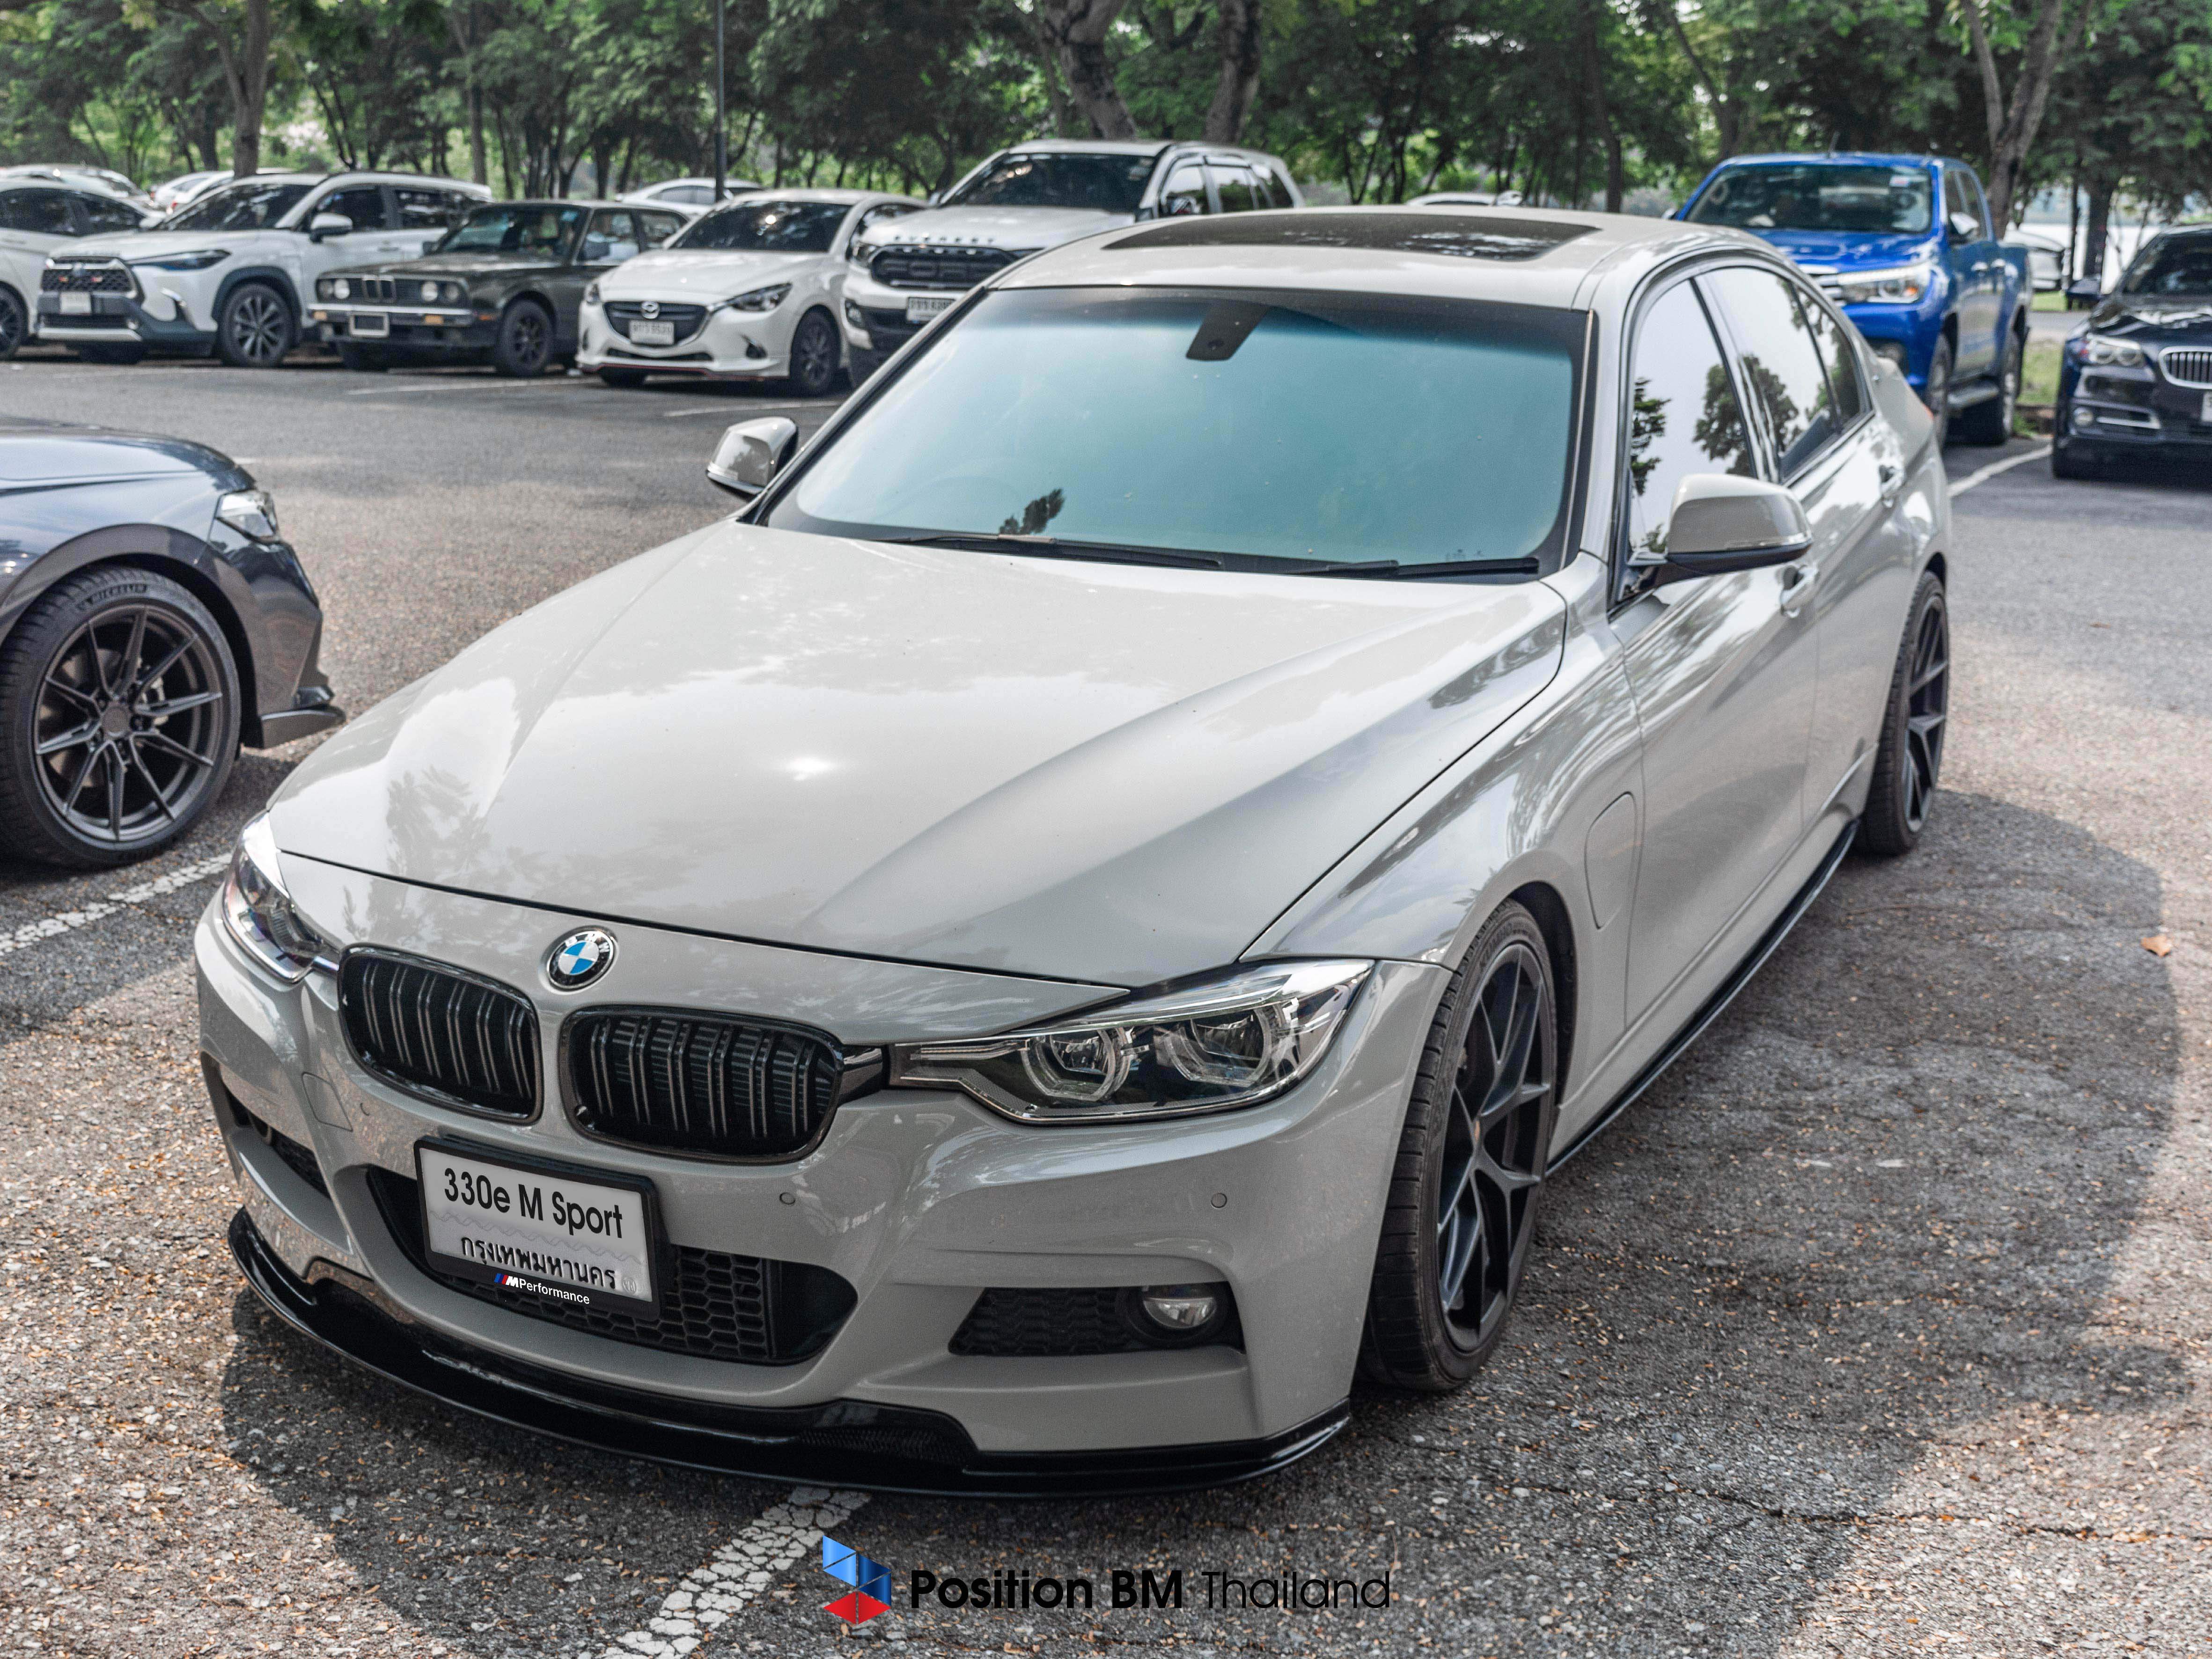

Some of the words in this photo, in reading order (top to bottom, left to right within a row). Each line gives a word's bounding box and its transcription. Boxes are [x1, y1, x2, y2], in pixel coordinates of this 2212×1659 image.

[444, 1168, 510, 1213] 330e
[518, 1184, 544, 1221] M
[552, 1191, 623, 1239] Sport
[461, 1237, 616, 1289] กรุงเทพมหานคร
